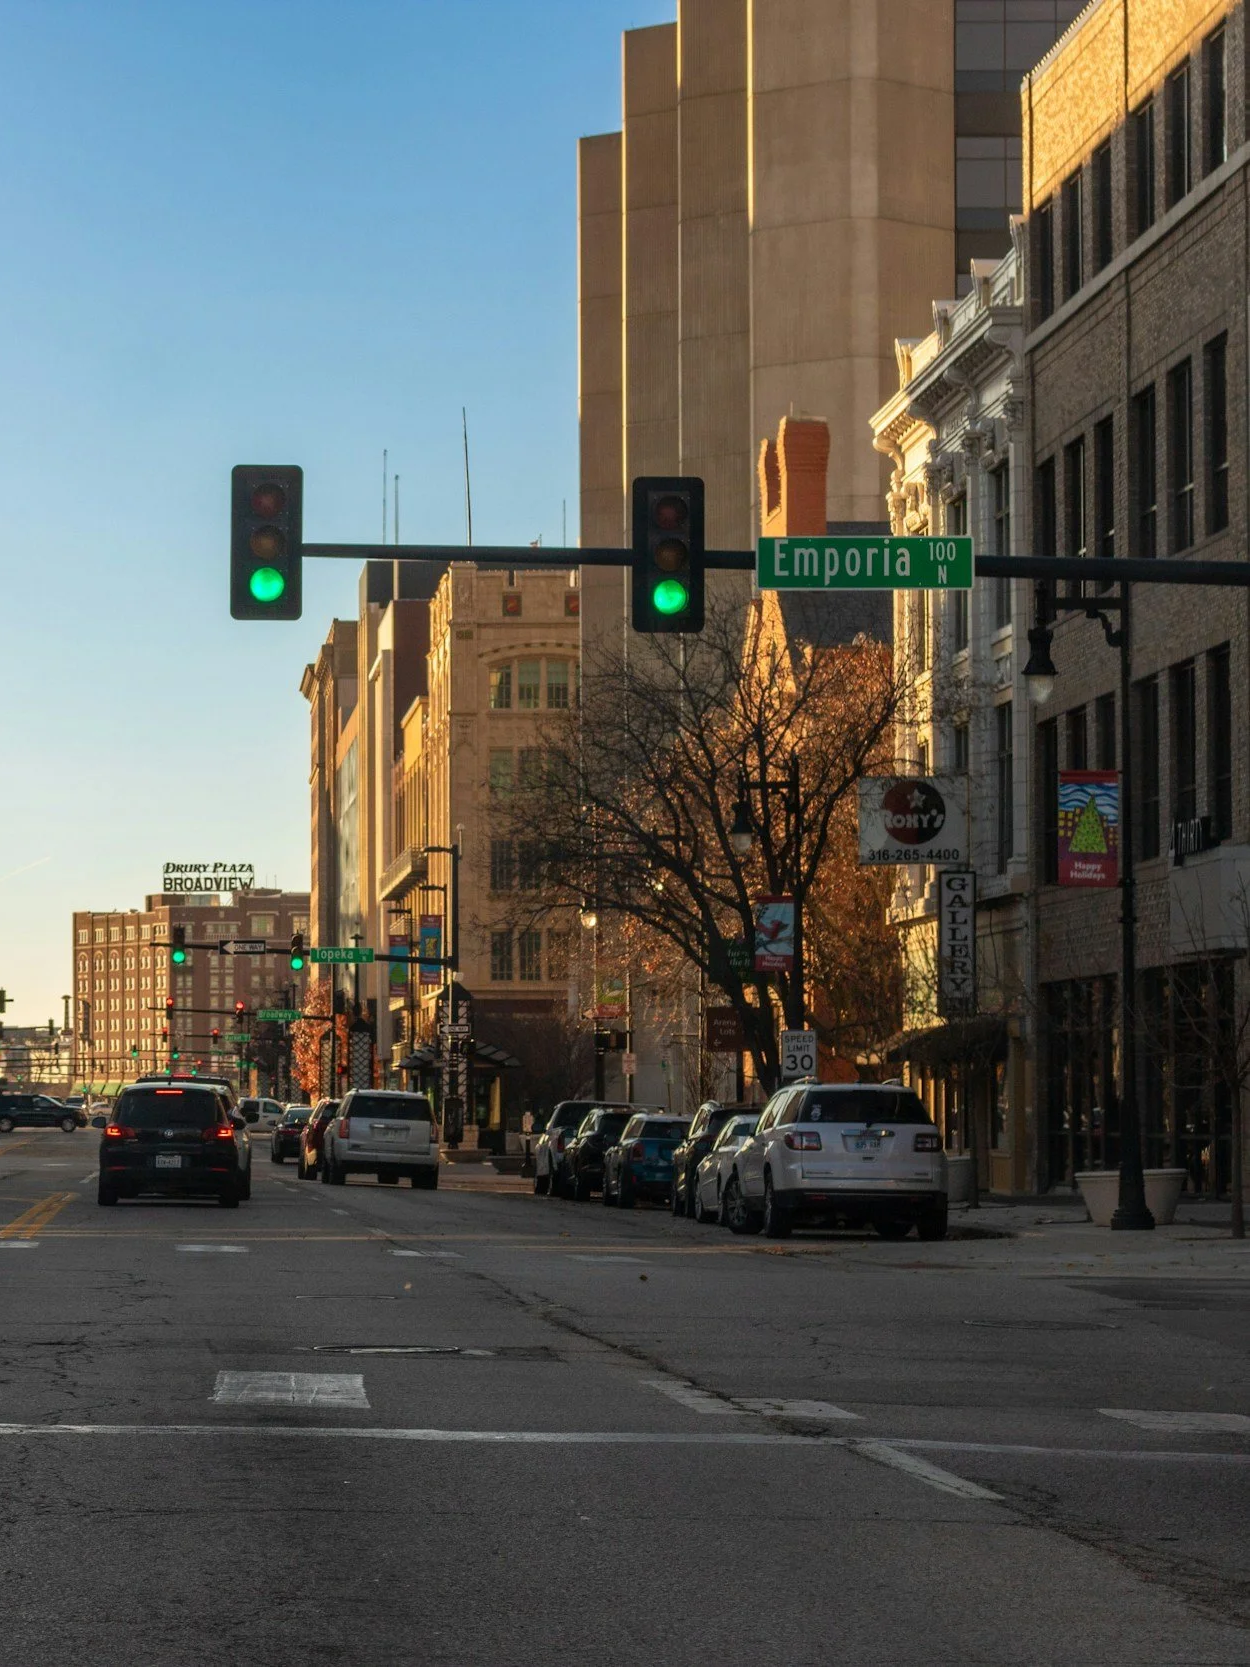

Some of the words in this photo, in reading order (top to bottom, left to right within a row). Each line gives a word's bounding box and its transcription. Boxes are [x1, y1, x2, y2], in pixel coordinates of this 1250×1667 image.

[774, 539, 910, 586] Emporia
[928, 541, 956, 561] 100
[938, 565, 947, 584] N
[869, 848, 960, 861] 316-265-4400
[164, 862, 209, 873] DRURY
[213, 862, 253, 873] PLAZA
[1074, 861, 1103, 871] Happy
[1069, 869, 1106, 881] Holidays
[163, 877, 254, 891] BROADVIEW
[946, 877, 969, 991] GALLERY
[234, 943, 247, 951] ONE
[249, 943, 262, 951] WAY
[316, 948, 353, 962] Topeka
[259, 1010, 292, 1020] Broadway
[713, 1019, 737, 1027] Arena
[719, 1028, 736, 1036] Lots
[784, 1035, 814, 1043] SPEED
[787, 1044, 810, 1052] LIMIT
[785, 1054, 813, 1071] 30
